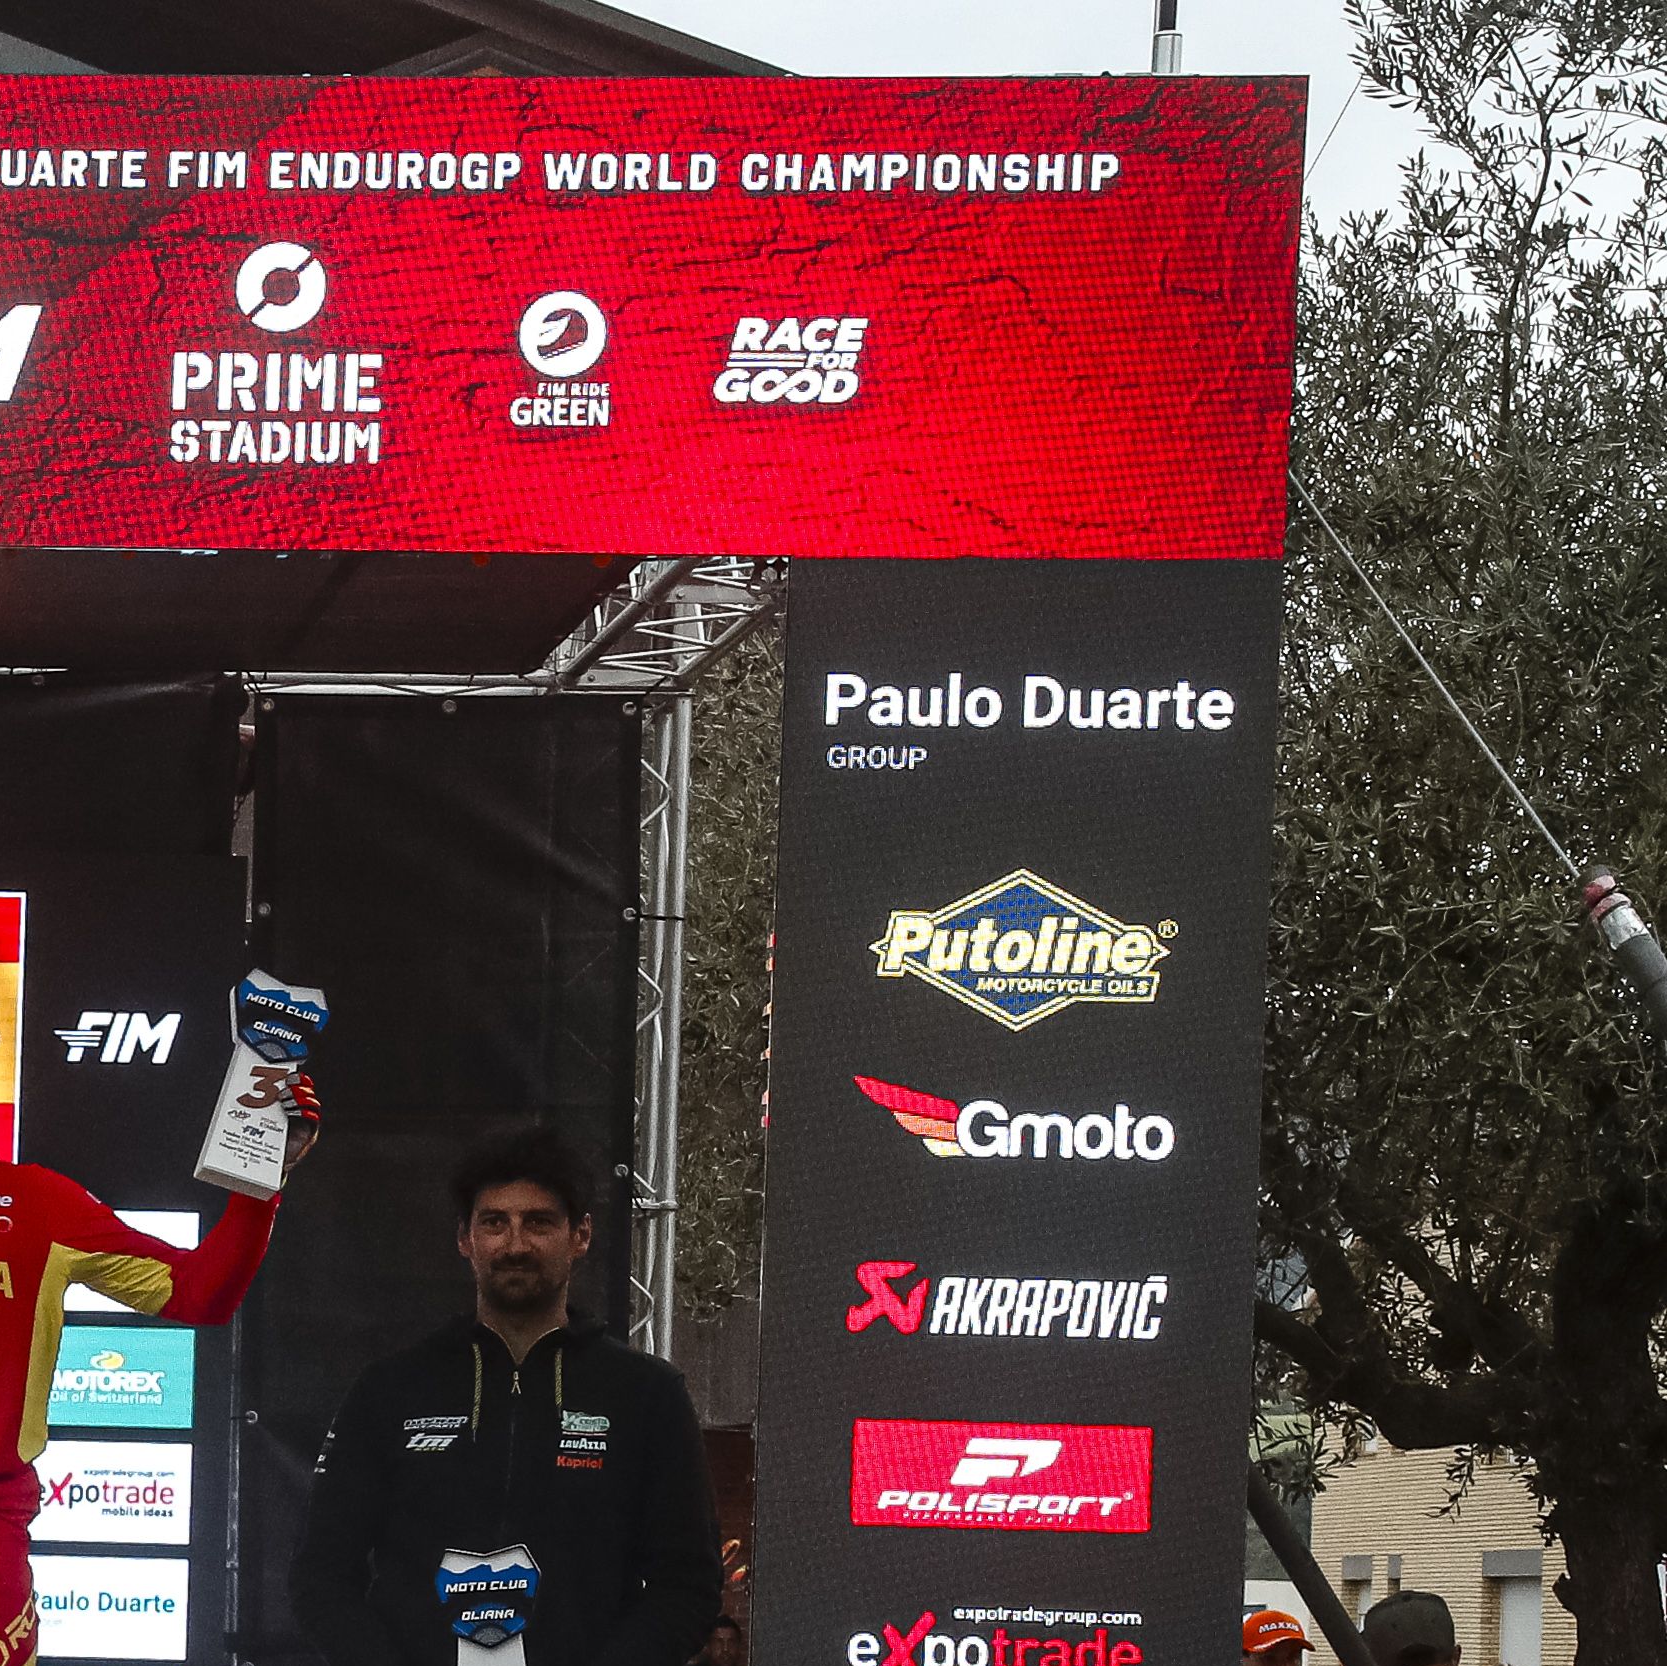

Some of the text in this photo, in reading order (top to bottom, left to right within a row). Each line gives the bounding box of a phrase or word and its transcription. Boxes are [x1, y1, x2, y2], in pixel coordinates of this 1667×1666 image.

[168, 152, 247, 190] FIM
[269, 151, 521, 191] ENDUROGP
[544, 153, 717, 193] WORLD
[740, 153, 1121, 193] CHAMPIONSHIP
[732, 317, 868, 354] RACE
[806, 352, 857, 370] FOR
[171, 352, 383, 414] PRIME
[538, 383, 567, 397] FIM
[713, 369, 860, 404] GOOD
[509, 397, 610, 428] GREEN
[170, 421, 381, 464] STADIUM
[824, 672, 1236, 732] Paulo Duarte
[827, 744, 928, 770] GROUP
[883, 915, 1156, 975] Putoline
[246, 993, 320, 1023] MOTO CLUB
[54, 1010, 182, 1066] FIM
[253, 1020, 302, 1043] OLIANA
[236, 1066, 292, 1109] 3
[956, 1099, 1176, 1161] Gmoto
[52, 1370, 162, 1392] MOTOREX
[559, 1438, 607, 1450] LAVAZZA
[556, 1456, 603, 1469] Kapriol
[877, 1490, 1124, 1517] POLISPORT
[445, 1579, 527, 1593] MOTO CLUB
[461, 1609, 515, 1621] OLIANA
